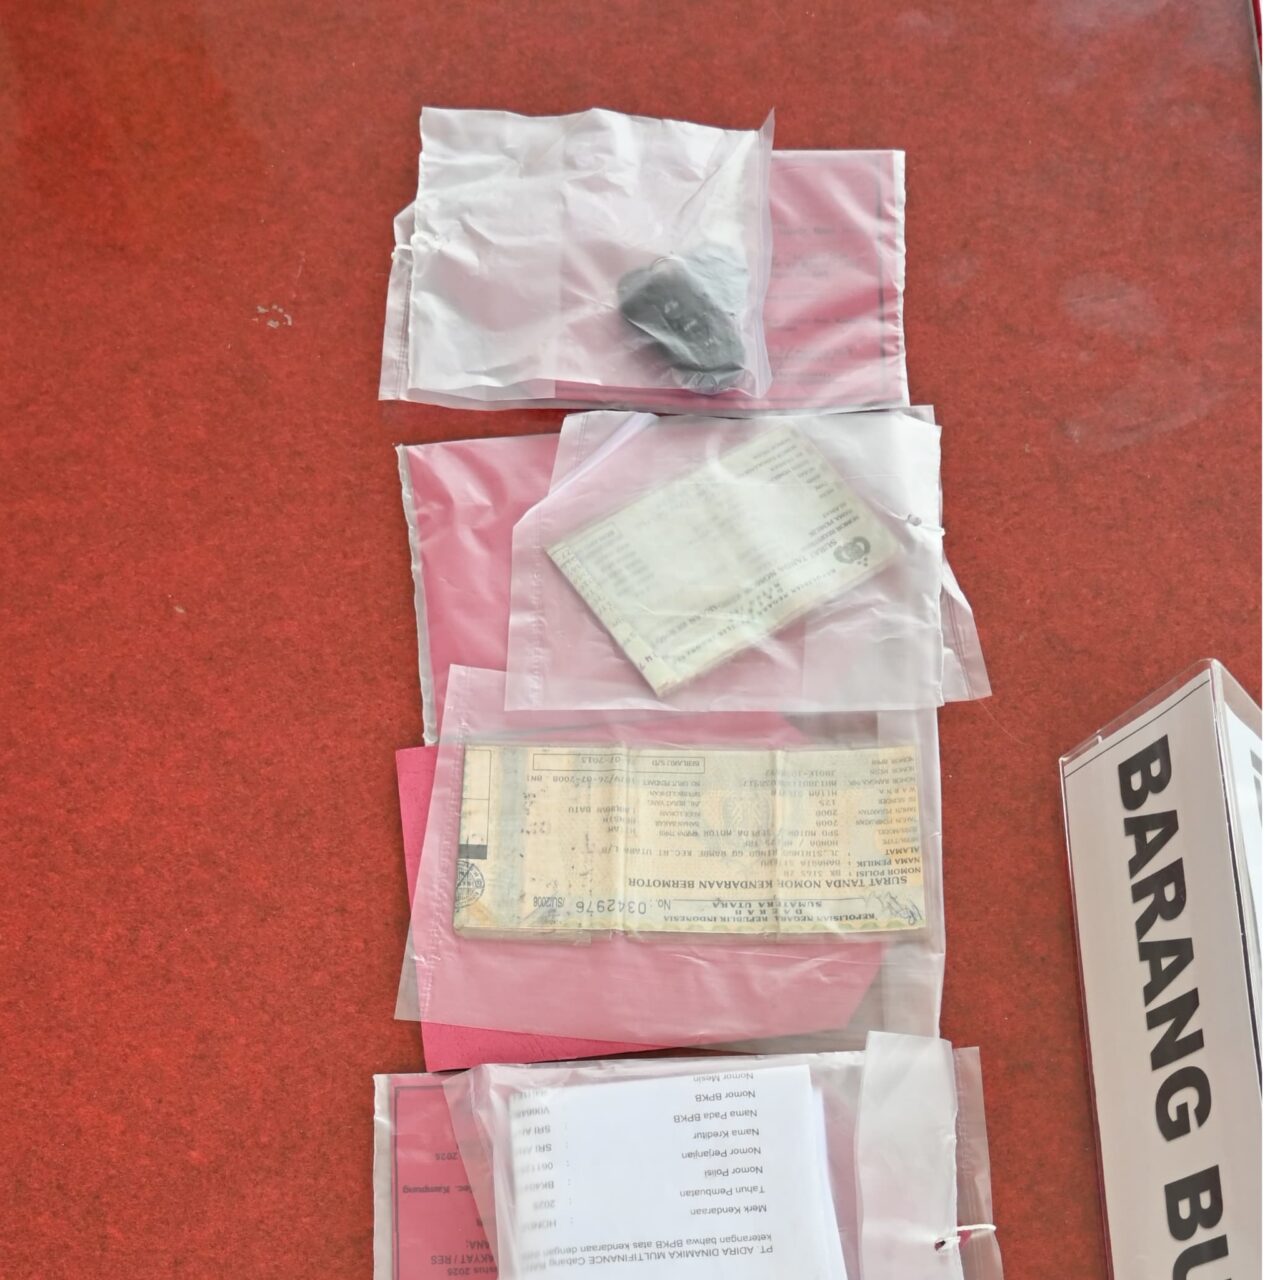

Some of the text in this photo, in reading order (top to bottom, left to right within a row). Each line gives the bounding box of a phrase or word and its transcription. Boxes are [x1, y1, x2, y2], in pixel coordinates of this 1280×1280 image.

[885, 847, 919, 855] ALAMAT
[856, 857, 920, 867] NAMA PEMILIK
[856, 867, 921, 877] NOMOR POLISI
[628, 875, 907, 889] SURAT TANDA NOMOR KENDARAAN BERMOTOR
[575, 899, 647, 914] 0342976
[712, 901, 752, 909] UTARA
[1117, 733, 1213, 1144] BARANG
[693, 1072, 753, 1084] Nomor Mesin
[695, 1089, 756, 1103] Nomor BPKB
[673, 1108, 757, 1123] Nama Pada BPKB
[693, 1128, 759, 1141] Nama Kreditur
[681, 1146, 761, 1160] Nomor Perjanjian
[704, 1166, 763, 1179] Nomor Polisi
[403, 1185, 450, 1194] Kampung
[680, 1185, 764, 1199] Tahun Pembuatan
[690, 1204, 767, 1217] Merk Kendaraan
[580, 1232, 771, 1255] keterangan bahwa BPKB atas kendaraan
[588, 1250, 666, 1265] MULTIFINANCE
[668, 1248, 719, 1260] DINAMIKA
[722, 1246, 753, 1256] ADIRA
[431, 1255, 452, 1264] RES
